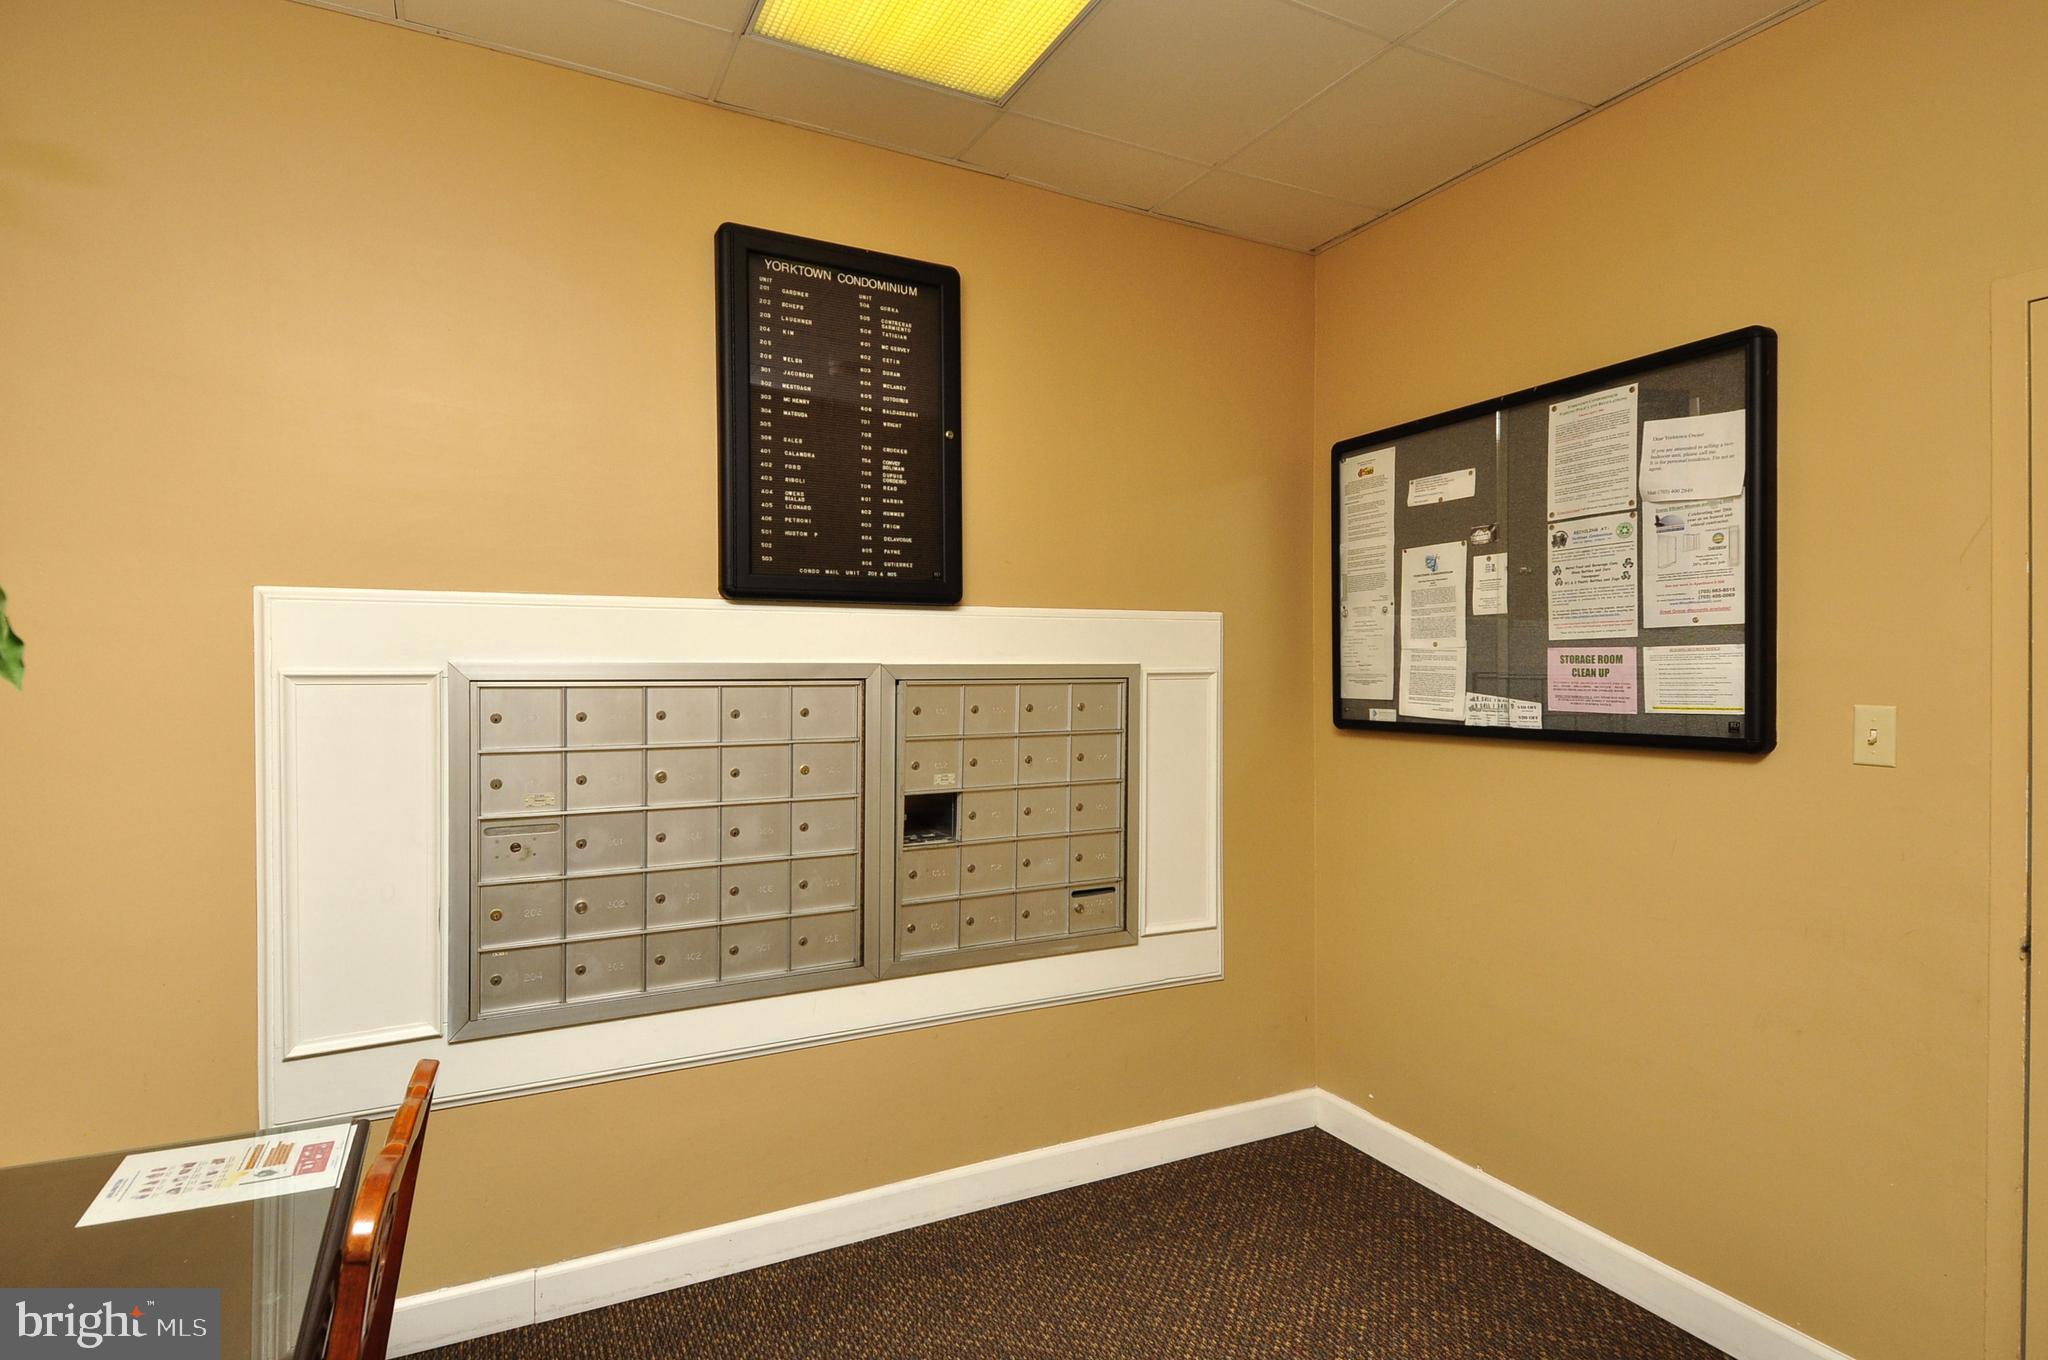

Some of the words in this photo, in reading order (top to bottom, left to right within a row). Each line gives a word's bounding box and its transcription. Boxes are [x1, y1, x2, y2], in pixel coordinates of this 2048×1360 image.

[764, 258, 832, 280] YORKTOWN
[837, 272, 918, 296] CONDOMINIUM
[1560, 655, 1595, 664] STORAGE
[1598, 655, 1623, 664] ROOM
[1572, 668, 1596, 677] CLEAN
[1599, 668, 1610, 677] UP
